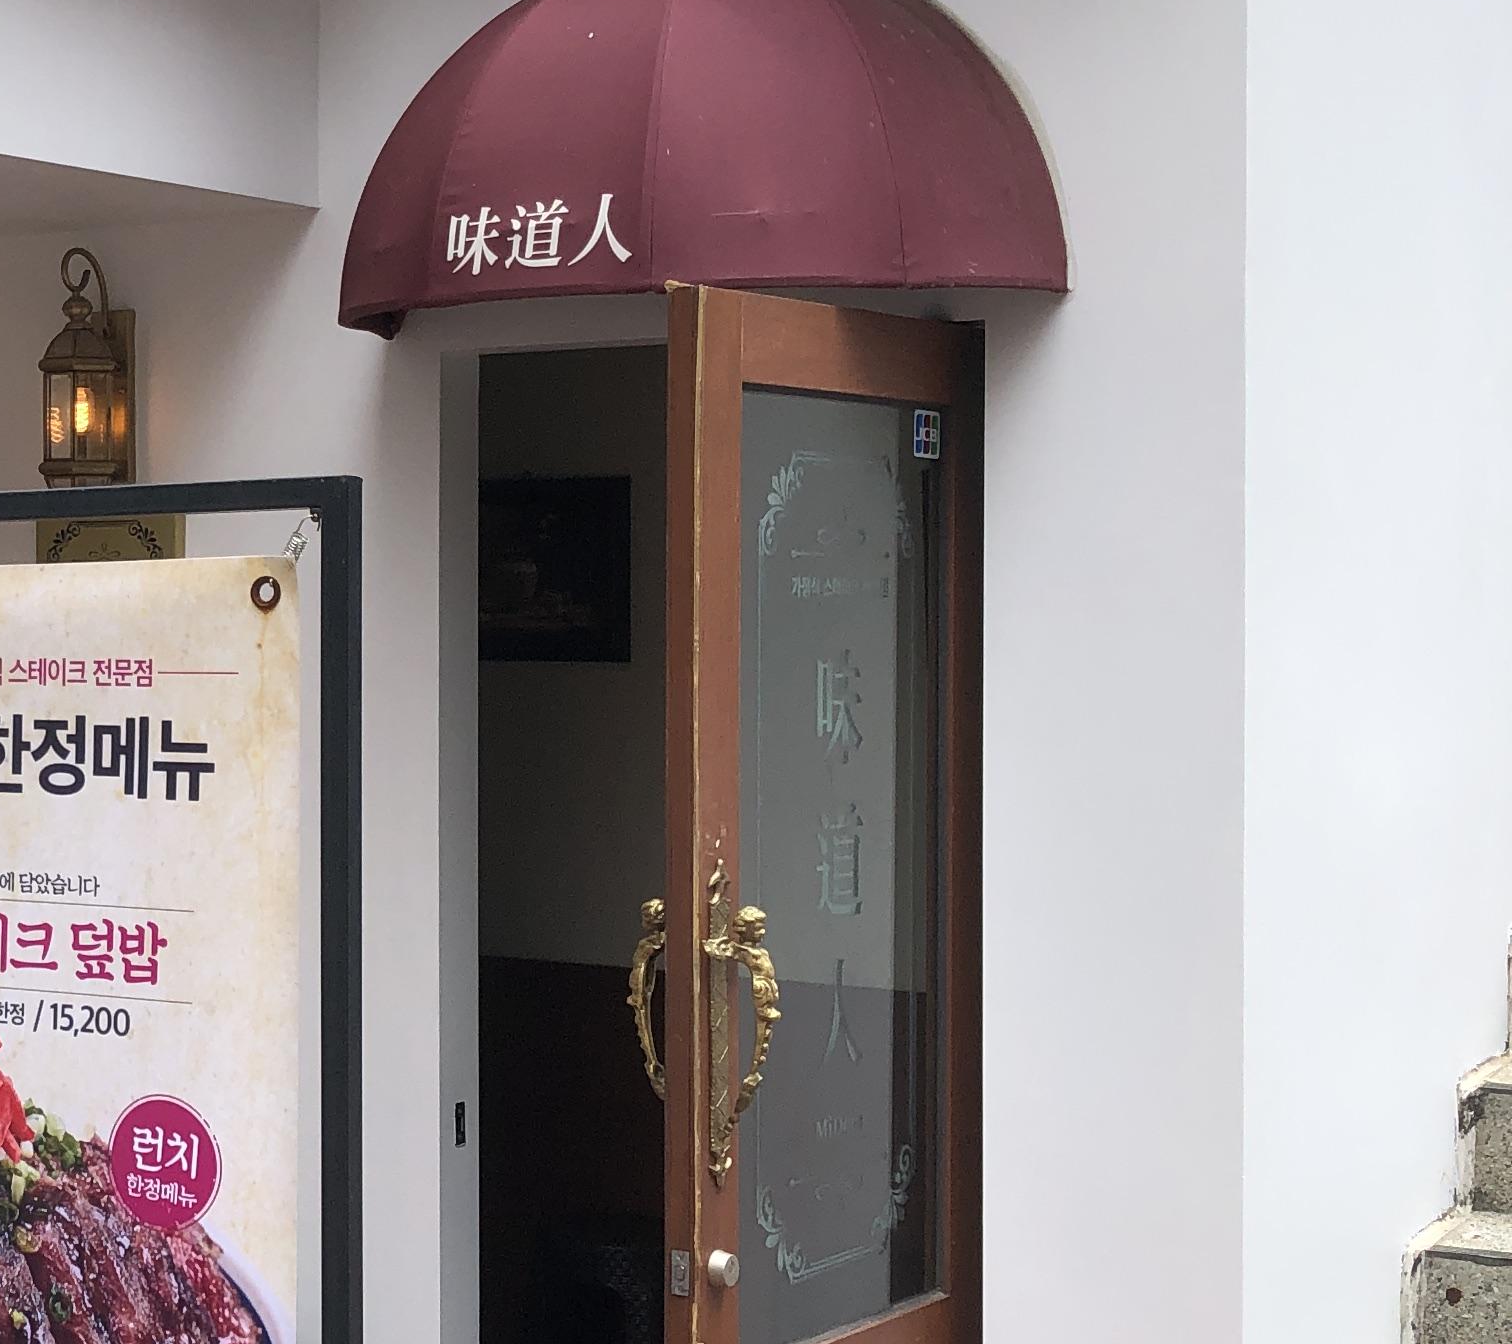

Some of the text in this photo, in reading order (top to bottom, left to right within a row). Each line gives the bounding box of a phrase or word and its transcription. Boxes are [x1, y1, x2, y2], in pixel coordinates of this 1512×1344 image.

[446, 193, 633, 276] 味道人
[8, 658, 88, 687] 스테이크
[92, 658, 154, 688] 전문점
[19, 872, 100, 897] 담았습니다
[71, 917, 168, 987] 덮밥
[49, 1002, 132, 1038] 15,200
[132, 1126, 199, 1180] 런치
[126, 1172, 198, 1209] 한정메뉴
